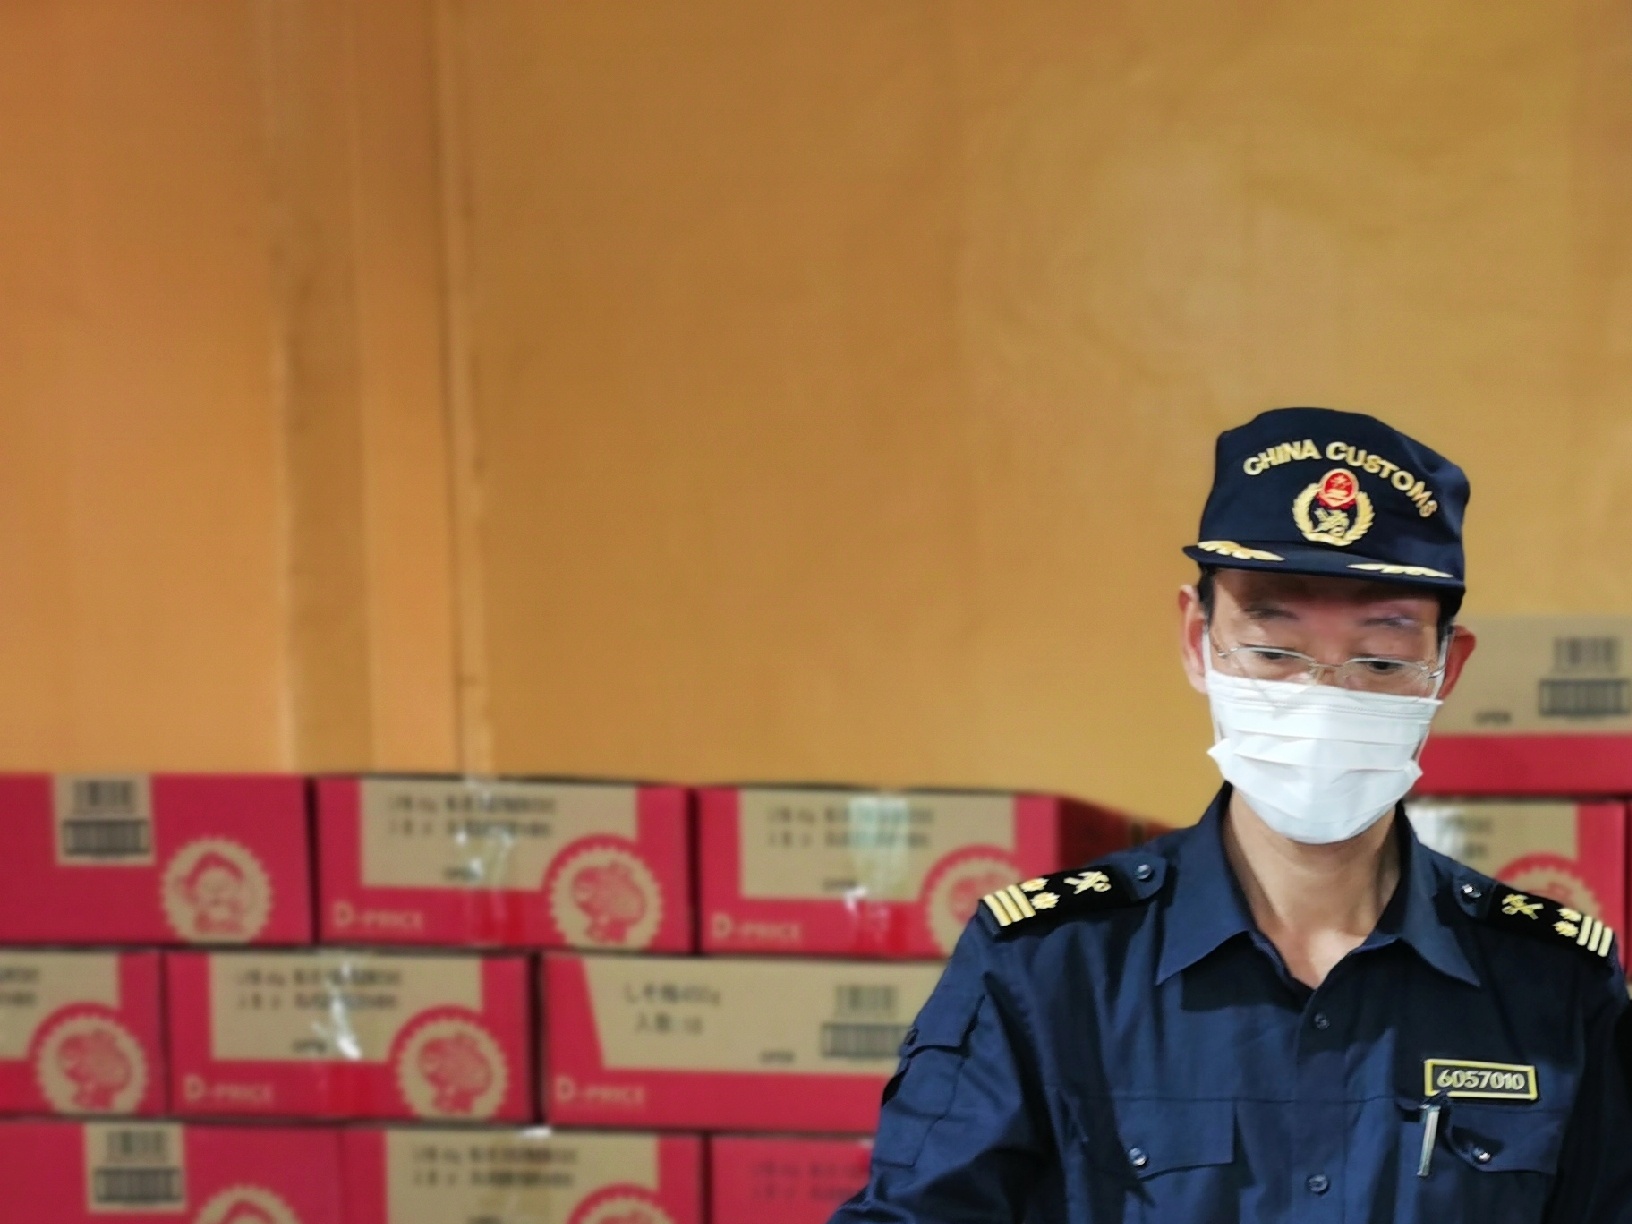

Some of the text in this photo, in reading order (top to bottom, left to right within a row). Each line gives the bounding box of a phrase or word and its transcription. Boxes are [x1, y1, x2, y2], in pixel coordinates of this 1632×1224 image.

[1243, 438, 1438, 518] CHINA CUSTOMS
[1436, 1069, 1526, 1091] 6057010
